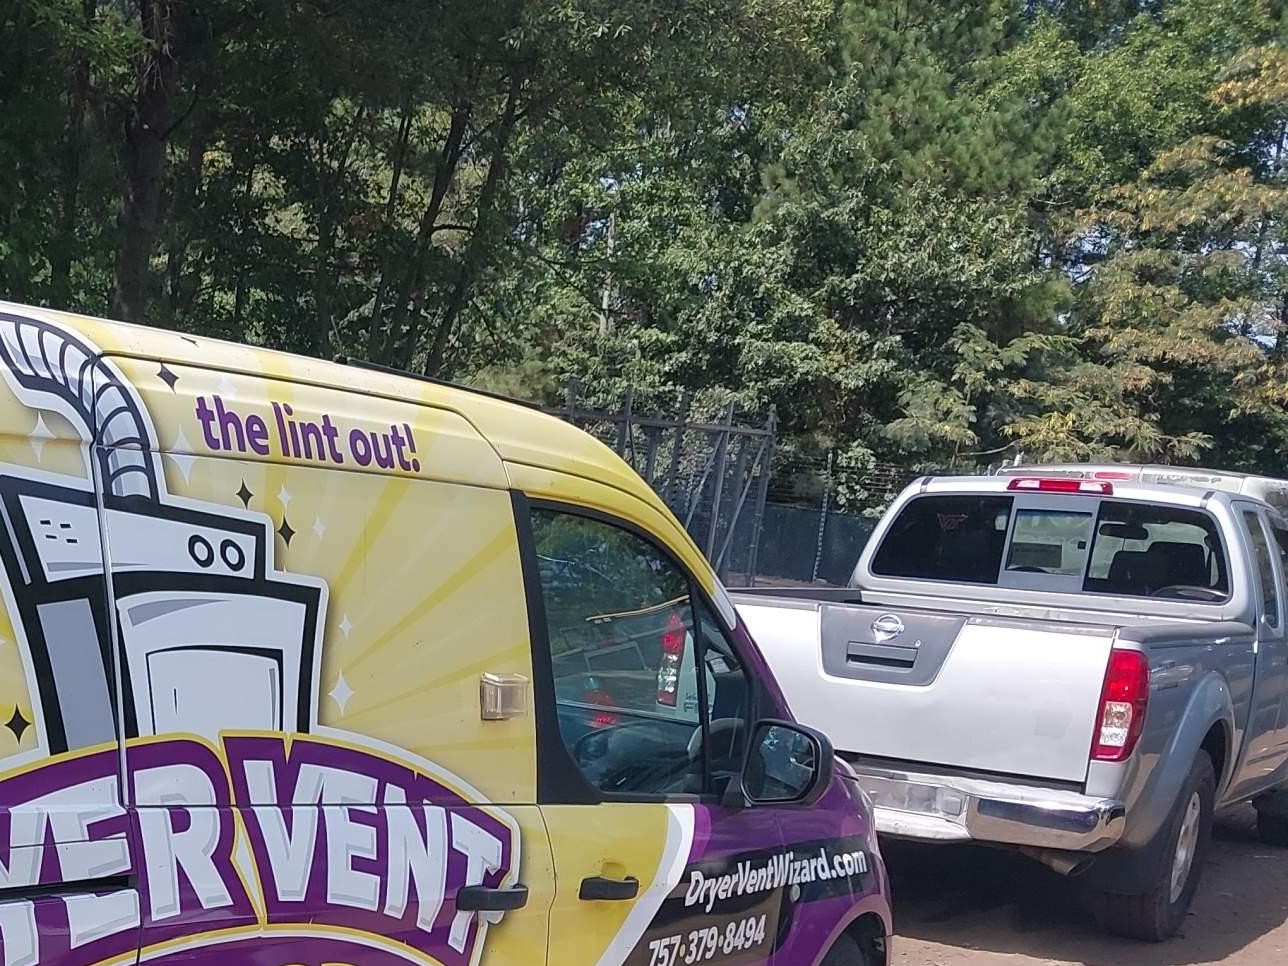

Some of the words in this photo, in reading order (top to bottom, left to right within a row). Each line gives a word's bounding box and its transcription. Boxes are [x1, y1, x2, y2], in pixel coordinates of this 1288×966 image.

[194, 393, 270, 458] the
[271, 400, 345, 467] lint
[348, 422, 423, 474] out!
[242, 758, 504, 956] VENT
[684, 848, 868, 914] DryerVentWizard.com
